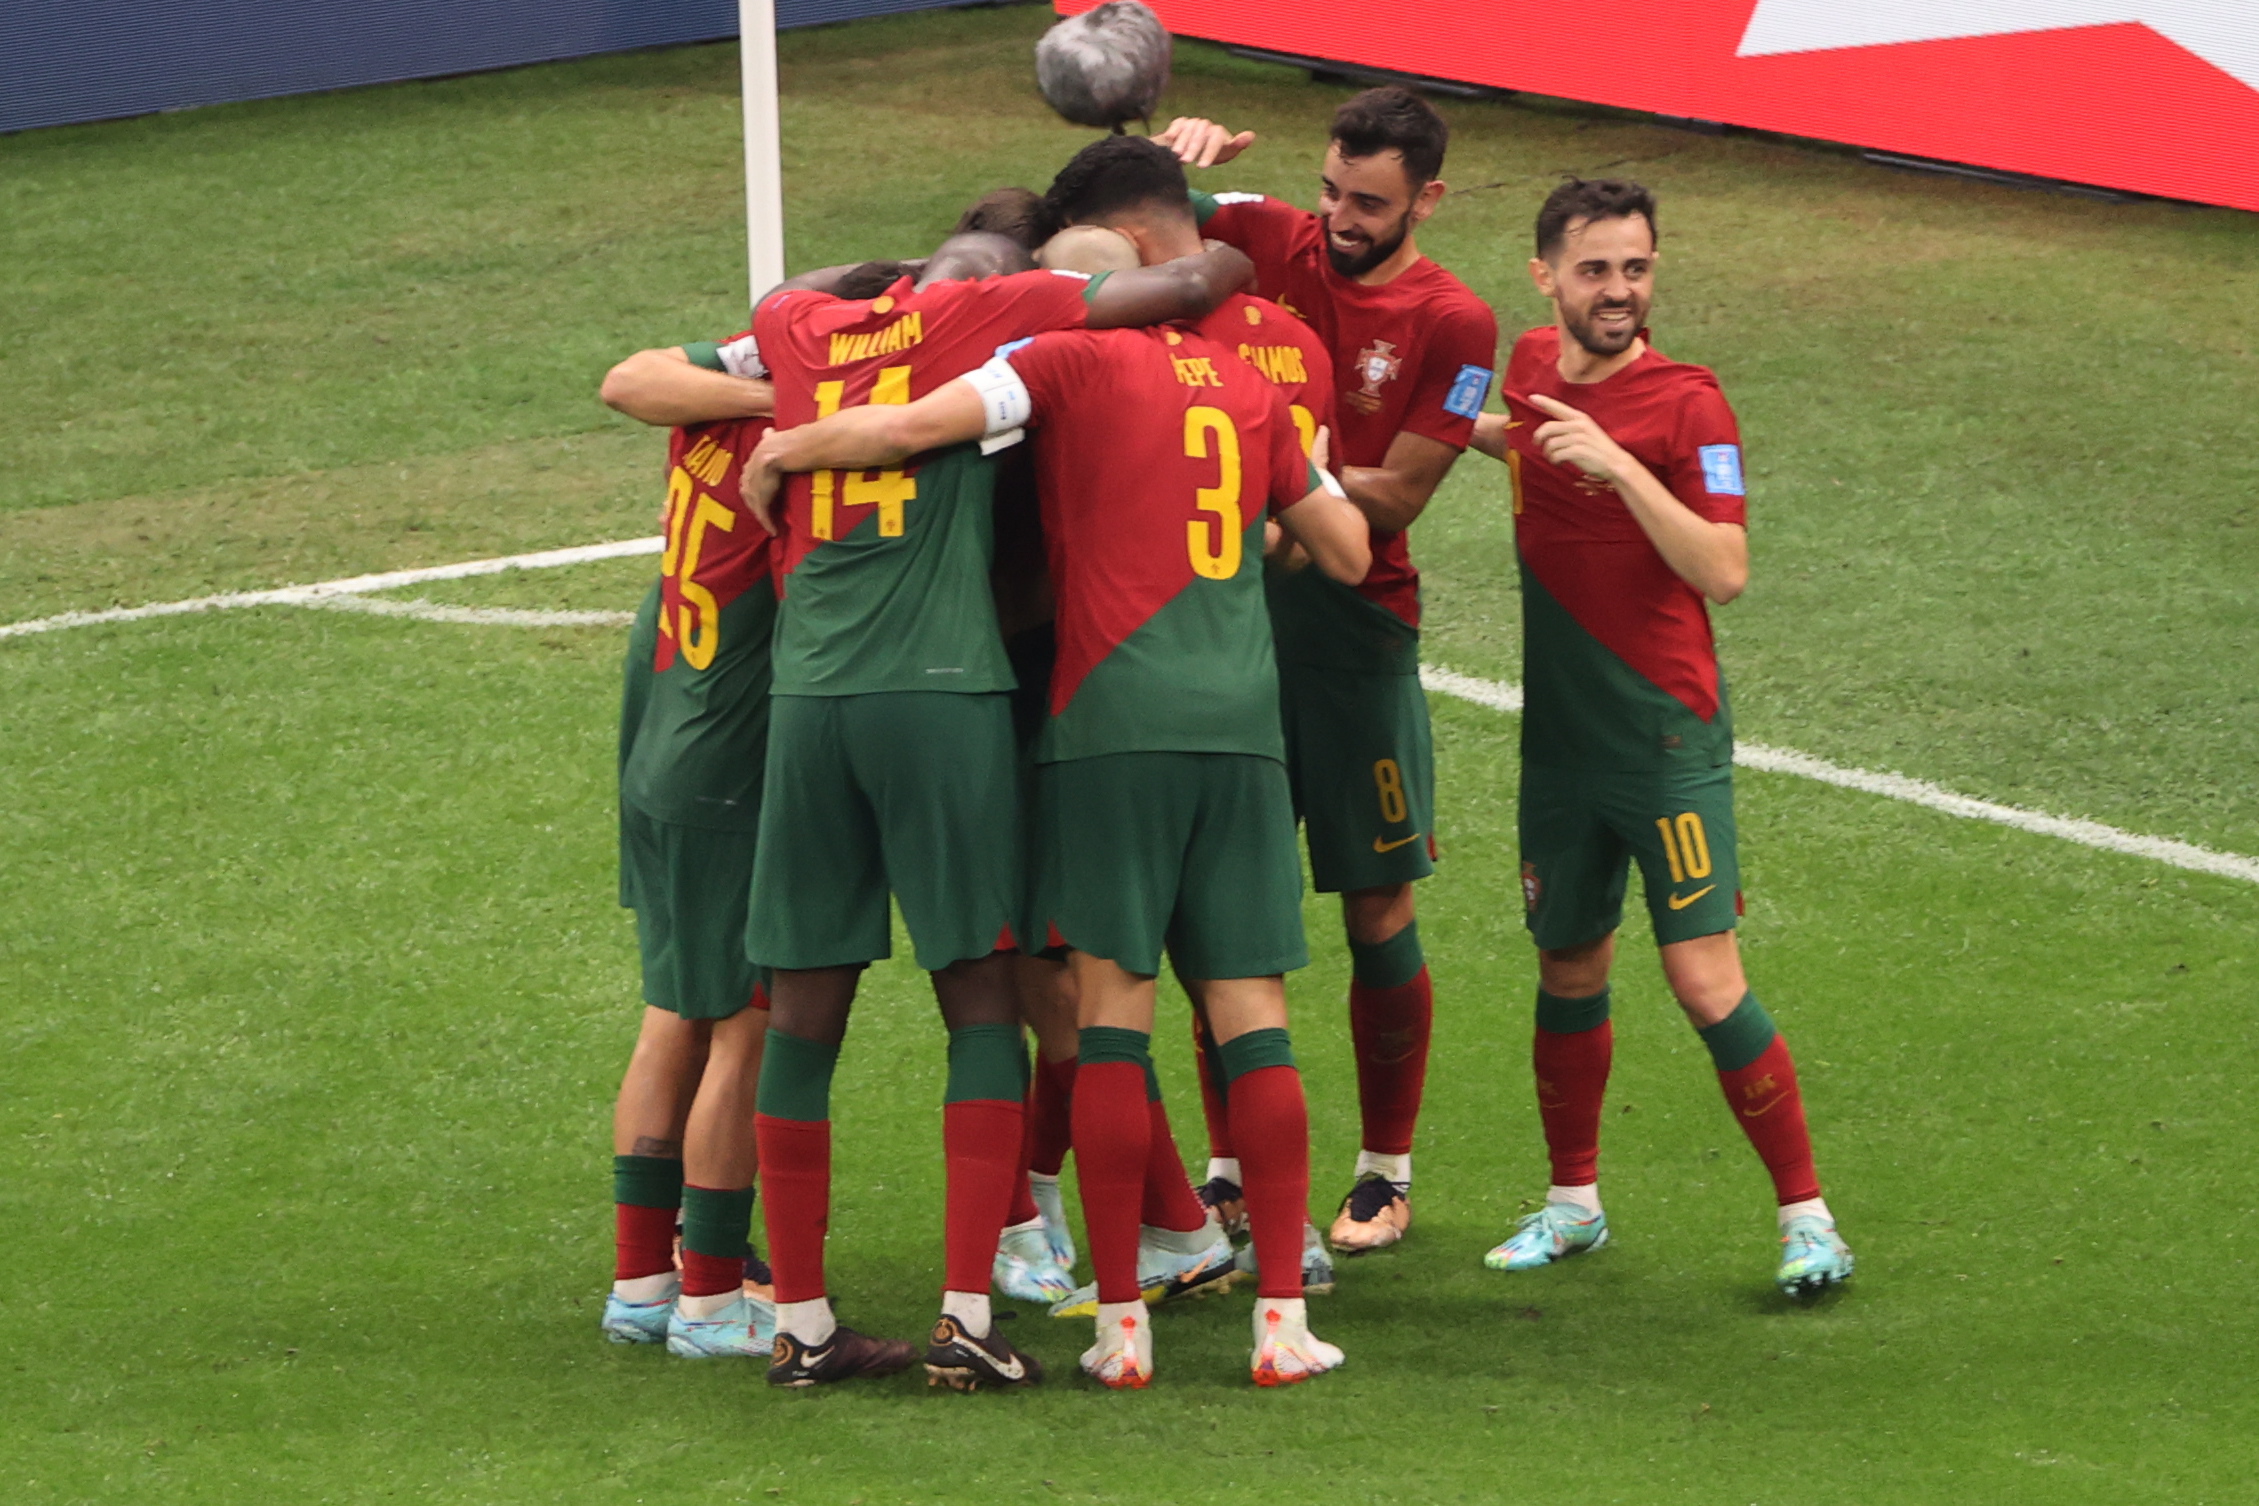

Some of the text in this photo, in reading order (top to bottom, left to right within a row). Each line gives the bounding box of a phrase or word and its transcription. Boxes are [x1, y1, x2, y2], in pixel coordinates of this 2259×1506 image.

[828, 311, 923, 366] WILLIAM
[1169, 353, 1224, 387] PEPE
[810, 365, 917, 541] 14
[1184, 405, 1242, 580] 3
[1373, 758, 1407, 823] 8
[1654, 811, 1712, 883] 10
